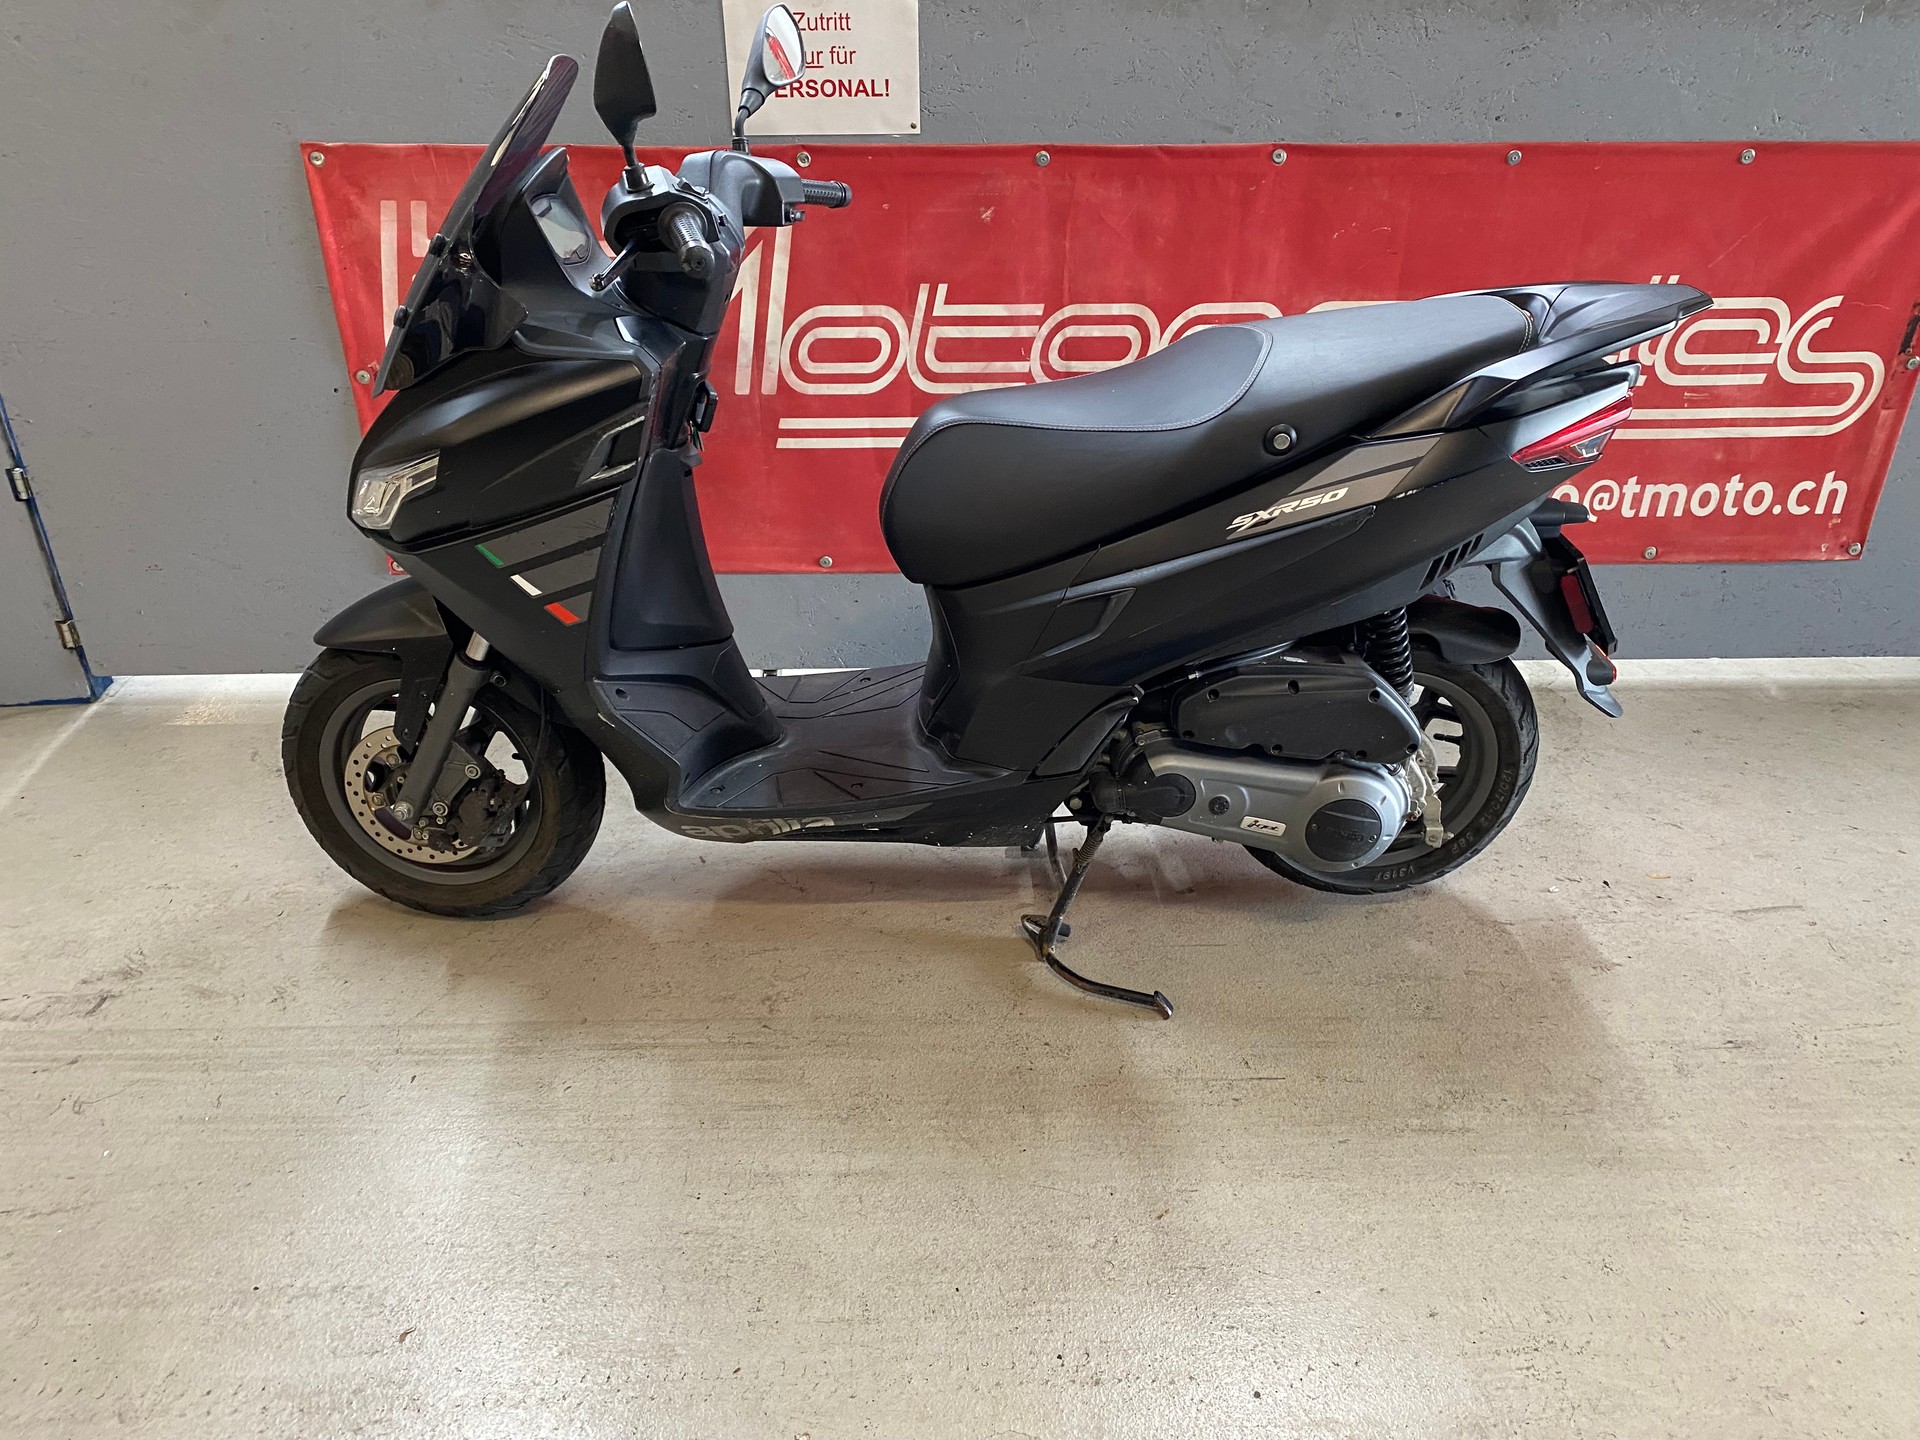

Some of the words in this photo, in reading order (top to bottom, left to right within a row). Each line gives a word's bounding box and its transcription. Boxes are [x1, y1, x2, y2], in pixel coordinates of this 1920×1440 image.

[793, 12, 852, 31] Zutritt
[804, 51, 824, 66] ur
[830, 46, 856, 64] für
[775, 79, 890, 98] ERSONAL!
[1226, 487, 1349, 532] SXR50
